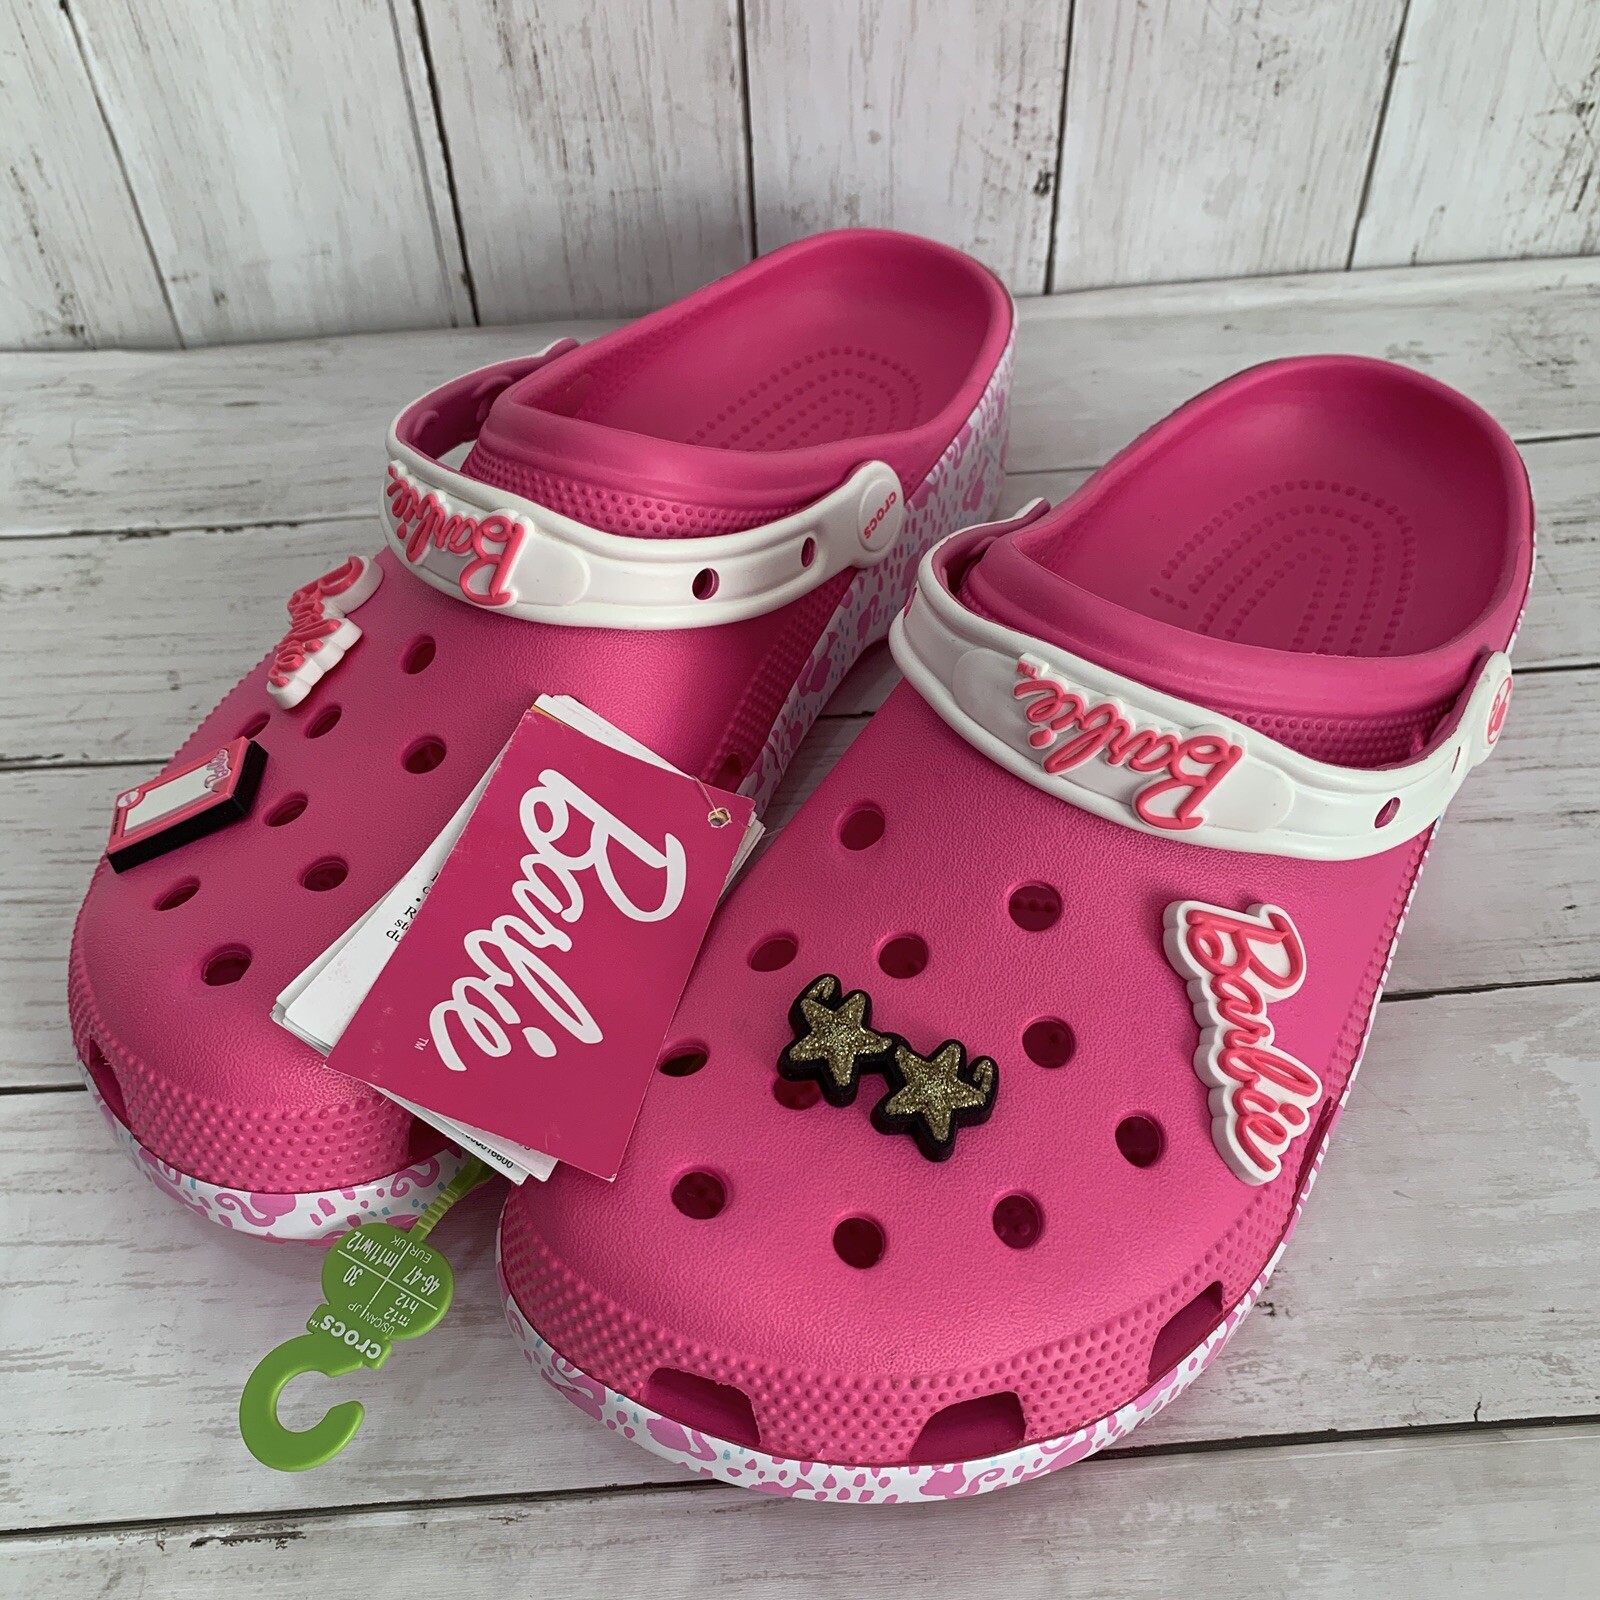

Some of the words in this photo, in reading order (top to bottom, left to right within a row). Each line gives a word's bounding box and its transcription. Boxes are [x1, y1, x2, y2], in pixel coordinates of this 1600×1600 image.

[864, 491, 896, 539] crocs
[386, 478, 525, 606] Barbie
[1013, 679, 1244, 831] Barbie
[428, 768, 687, 1071] Barbie
[1186, 909, 1319, 1172] Barbie
[347, 1231, 399, 1267] m11/w12
[391, 1235, 407, 1249] UK
[409, 1245, 432, 1264] EUR
[343, 1265, 363, 1286] 30
[402, 1265, 440, 1296] 46-47
[348, 1303, 362, 1312] JP
[384, 1307, 410, 1327] m12
[395, 1292, 419, 1314] h12
[320, 1315, 381, 1359] crocs
[364, 1311, 395, 1336] US/CAN
